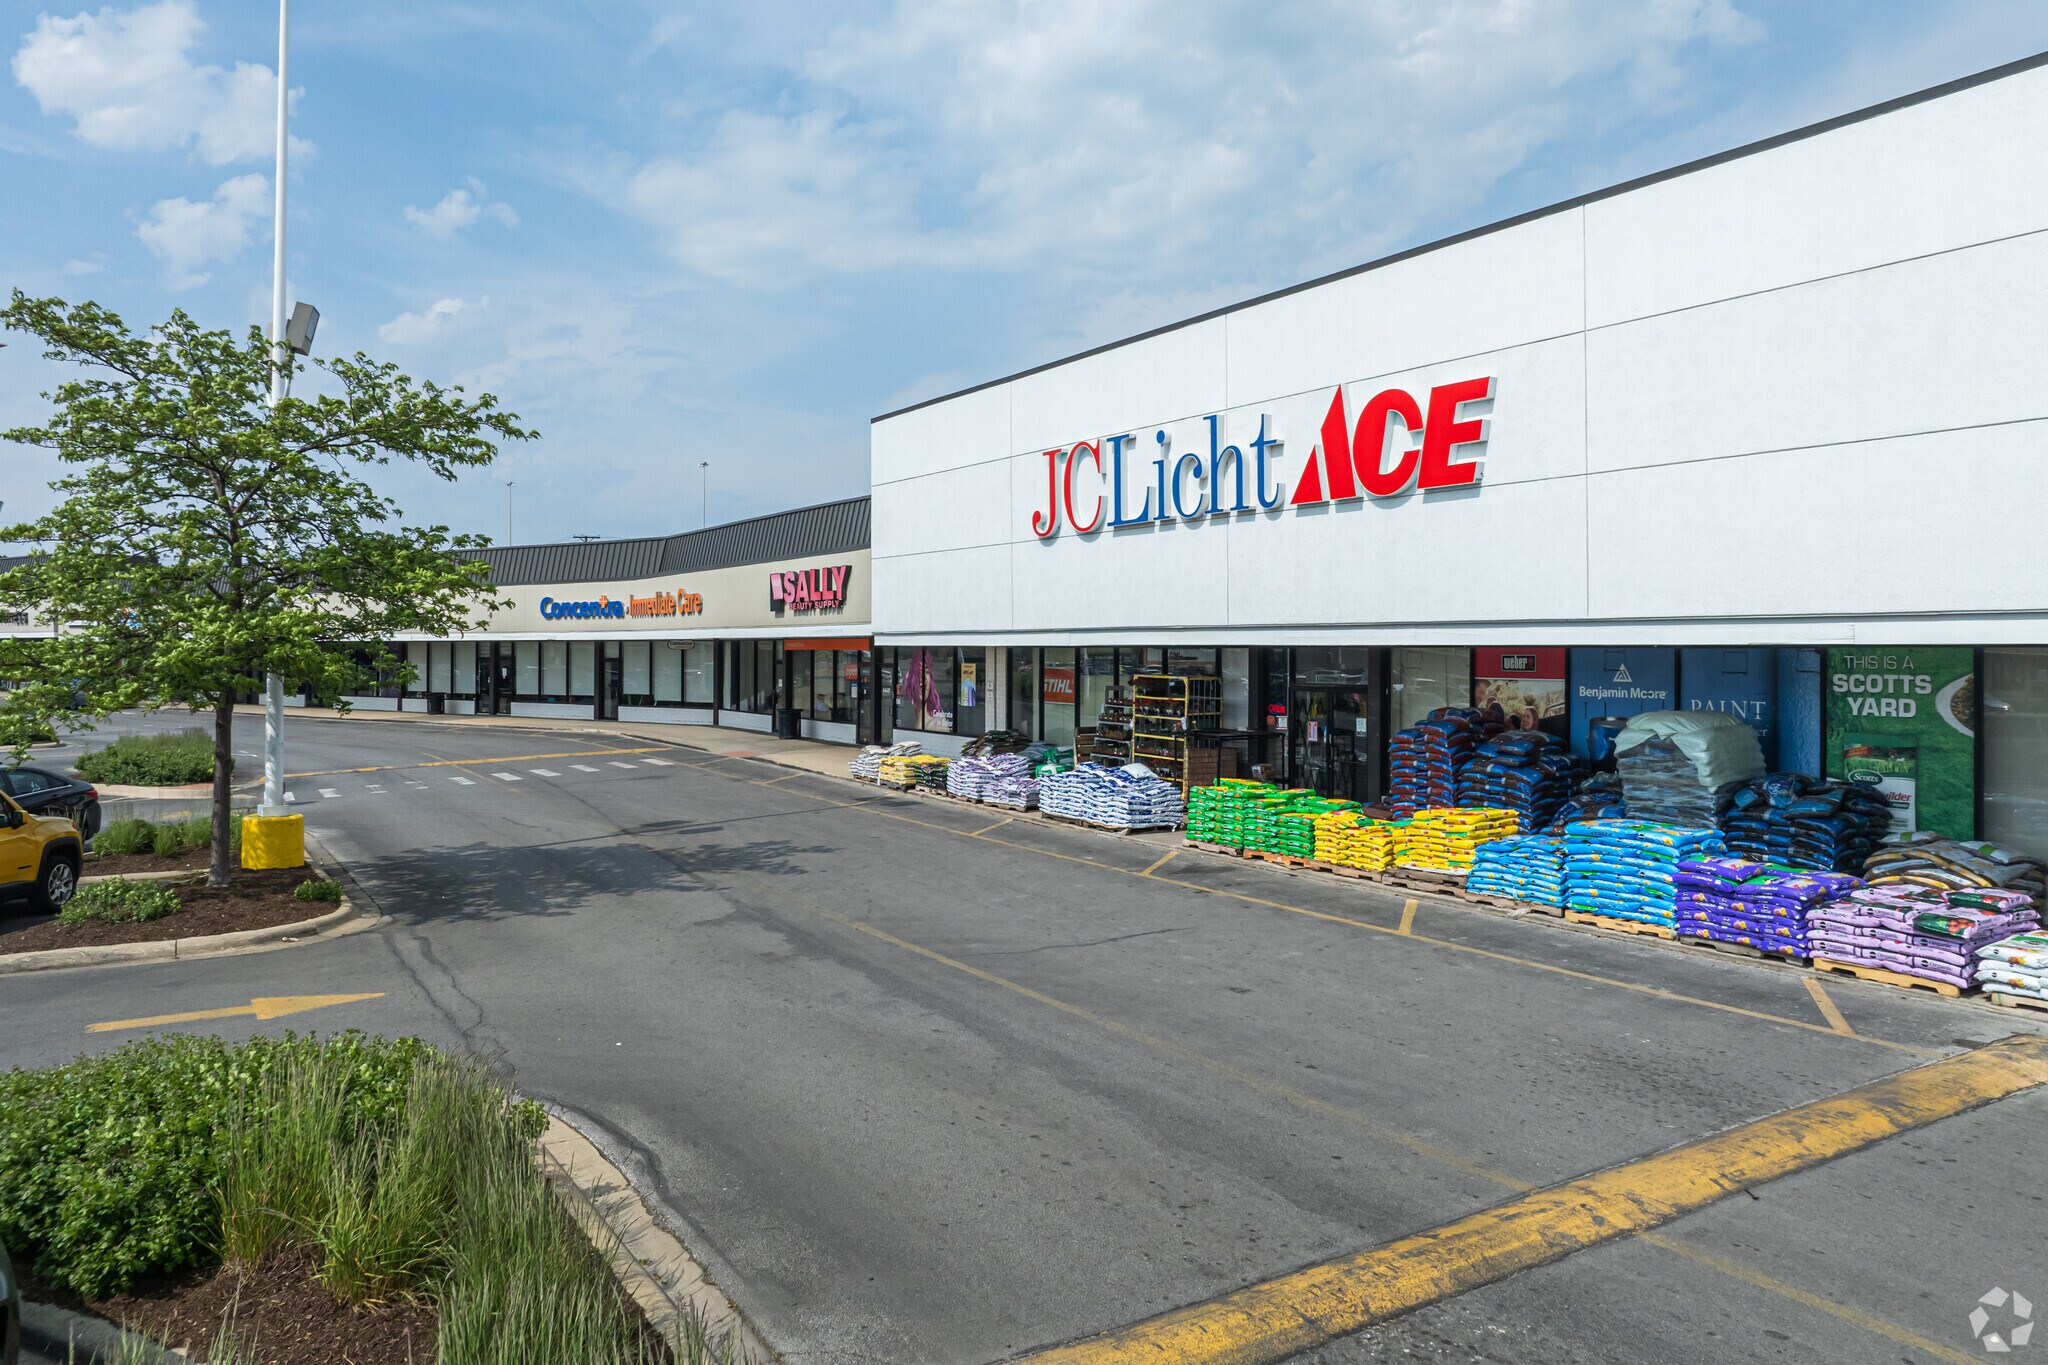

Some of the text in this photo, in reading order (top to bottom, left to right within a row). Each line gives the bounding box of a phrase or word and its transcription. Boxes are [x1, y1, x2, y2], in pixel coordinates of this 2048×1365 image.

[1290, 376, 1494, 505] ACE
[783, 565, 848, 603] SALLY
[540, 588, 702, 618] Concentra Immediate Care
[789, 600, 840, 610] BEAUTY SUPPLY
[1504, 655, 1527, 669] weber
[1844, 656, 1914, 669] THIS IS A
[1832, 674, 1932, 694] SCOTTS
[1579, 686, 1628, 700] Benjamin
[1847, 697, 1916, 717] YARD
[1854, 772, 1879, 782] Scotts
